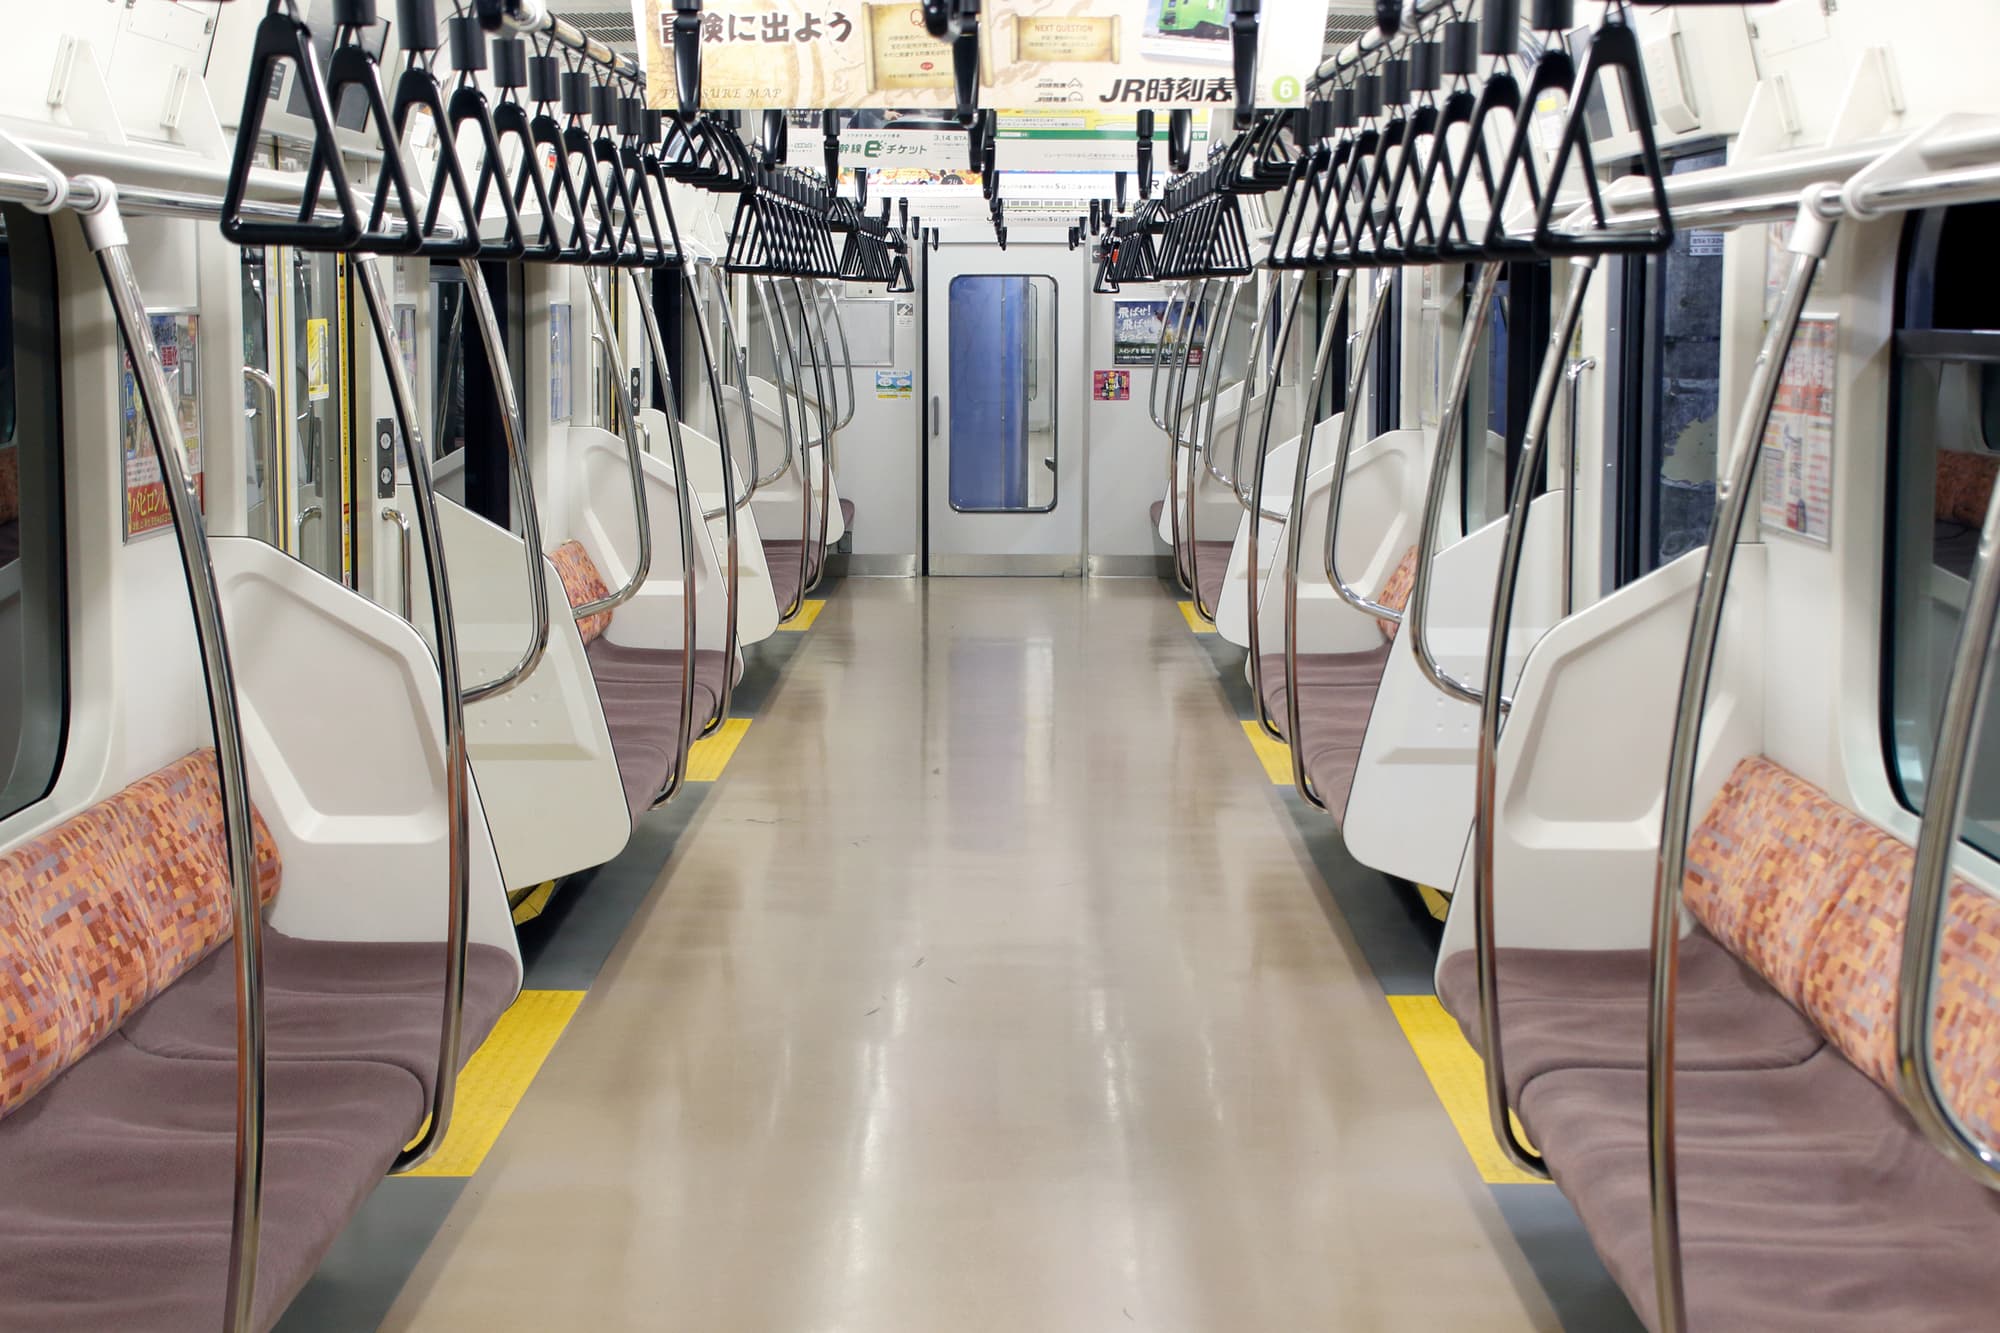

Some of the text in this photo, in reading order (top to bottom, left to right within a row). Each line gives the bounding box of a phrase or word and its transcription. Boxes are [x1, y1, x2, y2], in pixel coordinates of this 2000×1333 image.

[1034, 24, 1093, 32] NEXT QUESTION
[662, 88, 783, 98] TRSURE MAP
[1099, 77, 1236, 103] JR時刻表
[1279, 80, 1293, 99] 6
[839, 140, 928, 158] 幹線eチケット
